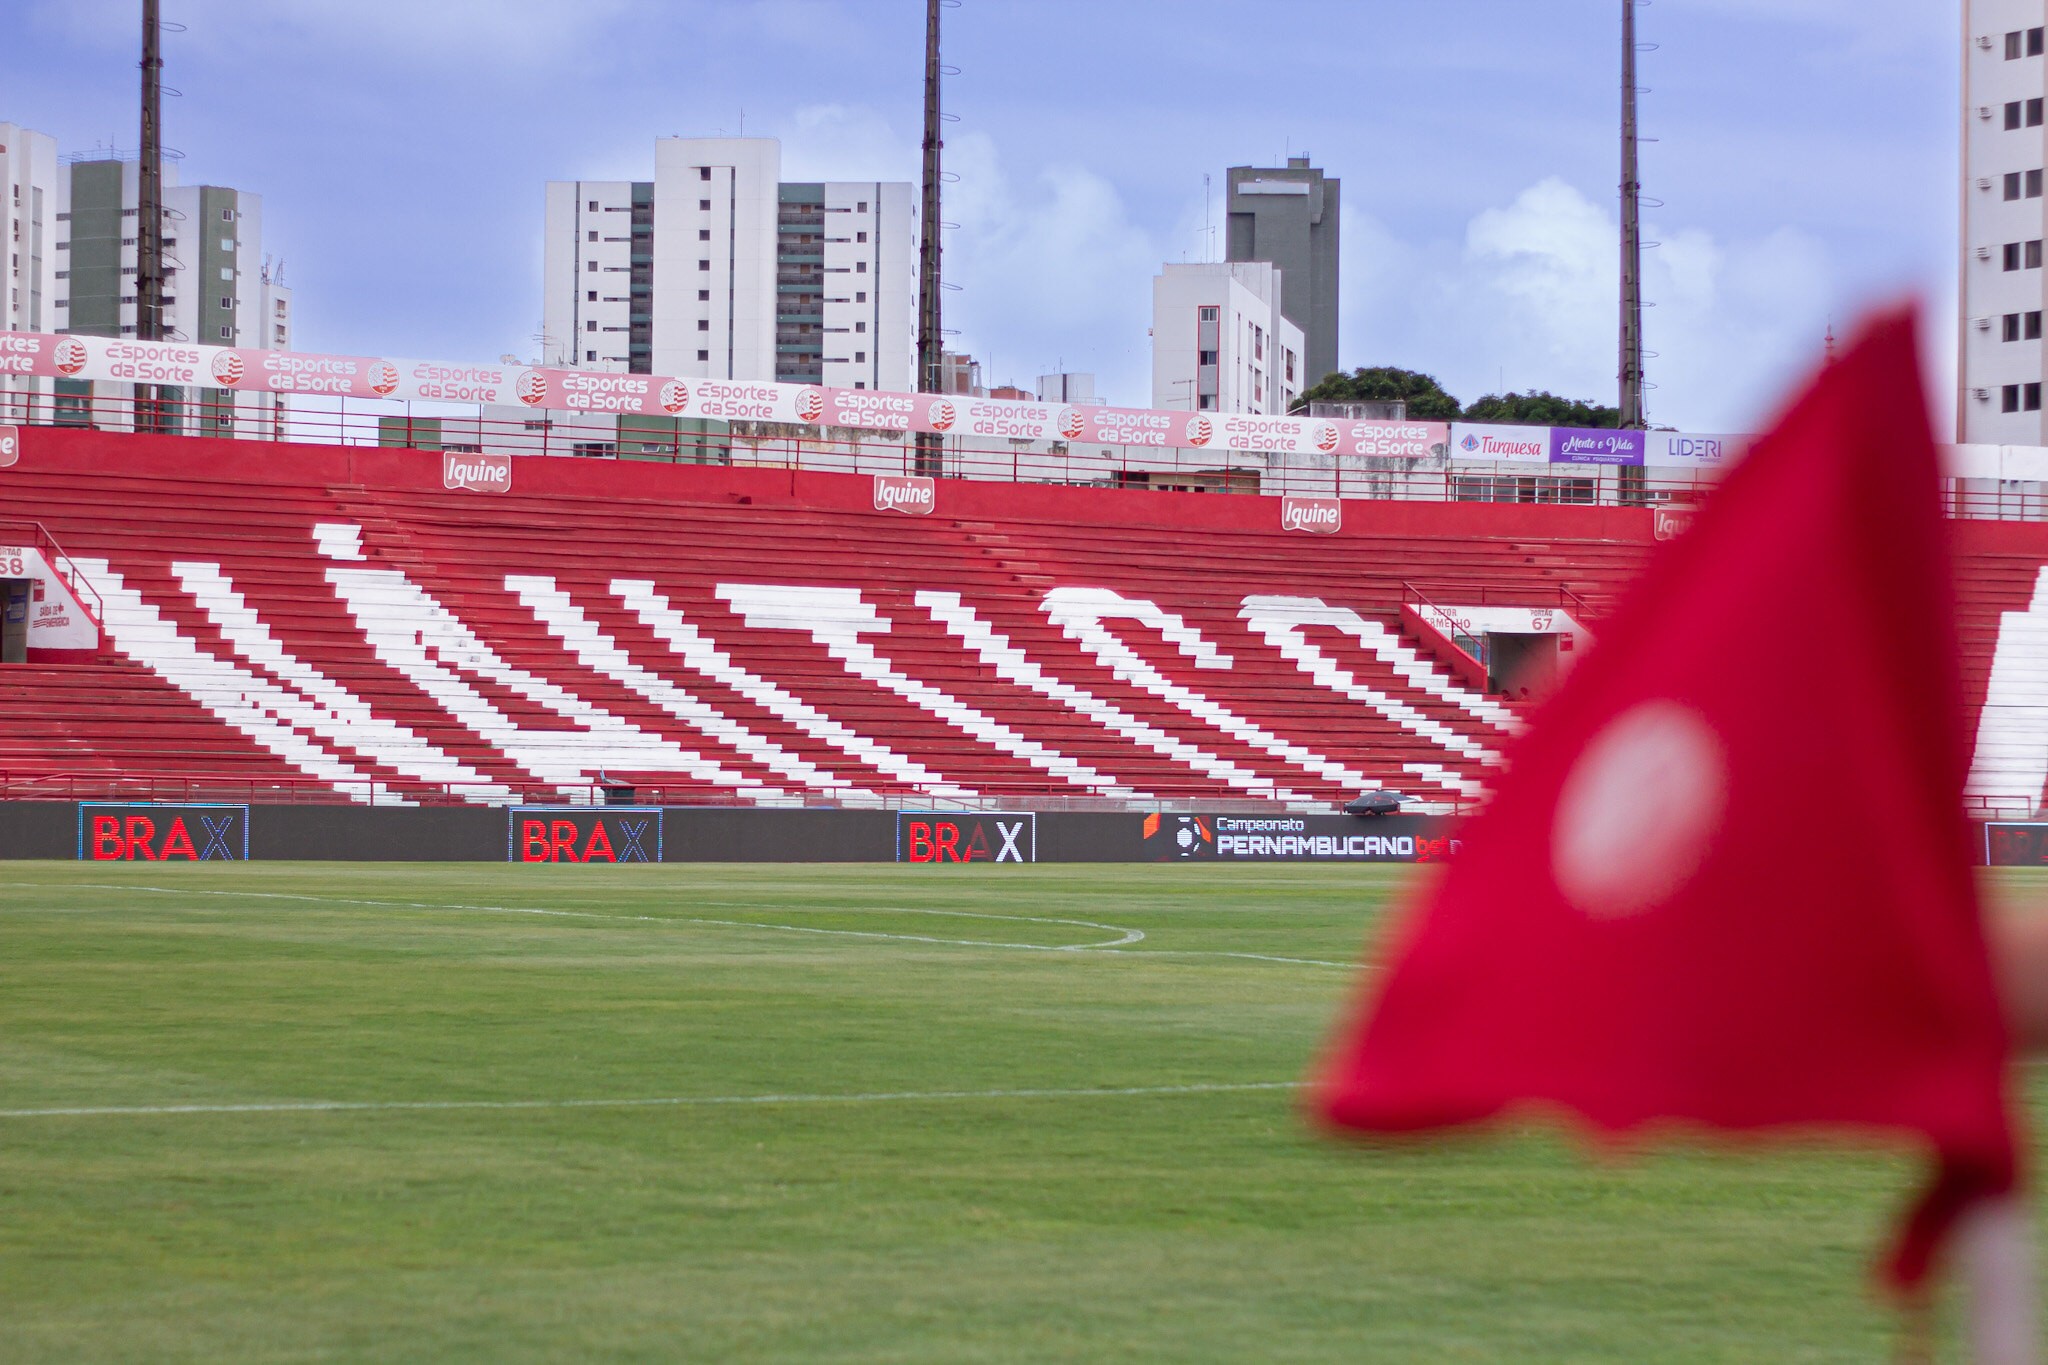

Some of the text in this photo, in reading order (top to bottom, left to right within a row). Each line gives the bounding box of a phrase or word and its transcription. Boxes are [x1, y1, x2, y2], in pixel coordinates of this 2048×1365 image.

[106, 342, 199, 365] Esportes
[263, 354, 357, 376] Esportes
[413, 364, 502, 384] Esportes
[562, 374, 648, 394] Esportes
[697, 383, 778, 401] Esportes
[834, 392, 914, 413] Esportes
[970, 402, 1048, 421] Esportes
[1094, 410, 1171, 429] Esportes
[1225, 417, 1301, 436] Esportes
[1351, 423, 1428, 441] Esportes
[1482, 436, 1541, 456] Turquesa
[1561, 435, 1635, 453] Mente e Vida
[448, 458, 508, 486] Iquine
[877, 480, 932, 507] Iquine
[1286, 502, 1338, 527] Iquine
[1532, 618, 1553, 631] 67
[1216, 817, 1305, 833] Campeonato
[93, 816, 234, 861] BRAX
[523, 819, 649, 863] BRAX
[909, 821, 1024, 863] BRAX
[1217, 835, 1413, 855] PERNAMBUCANO
